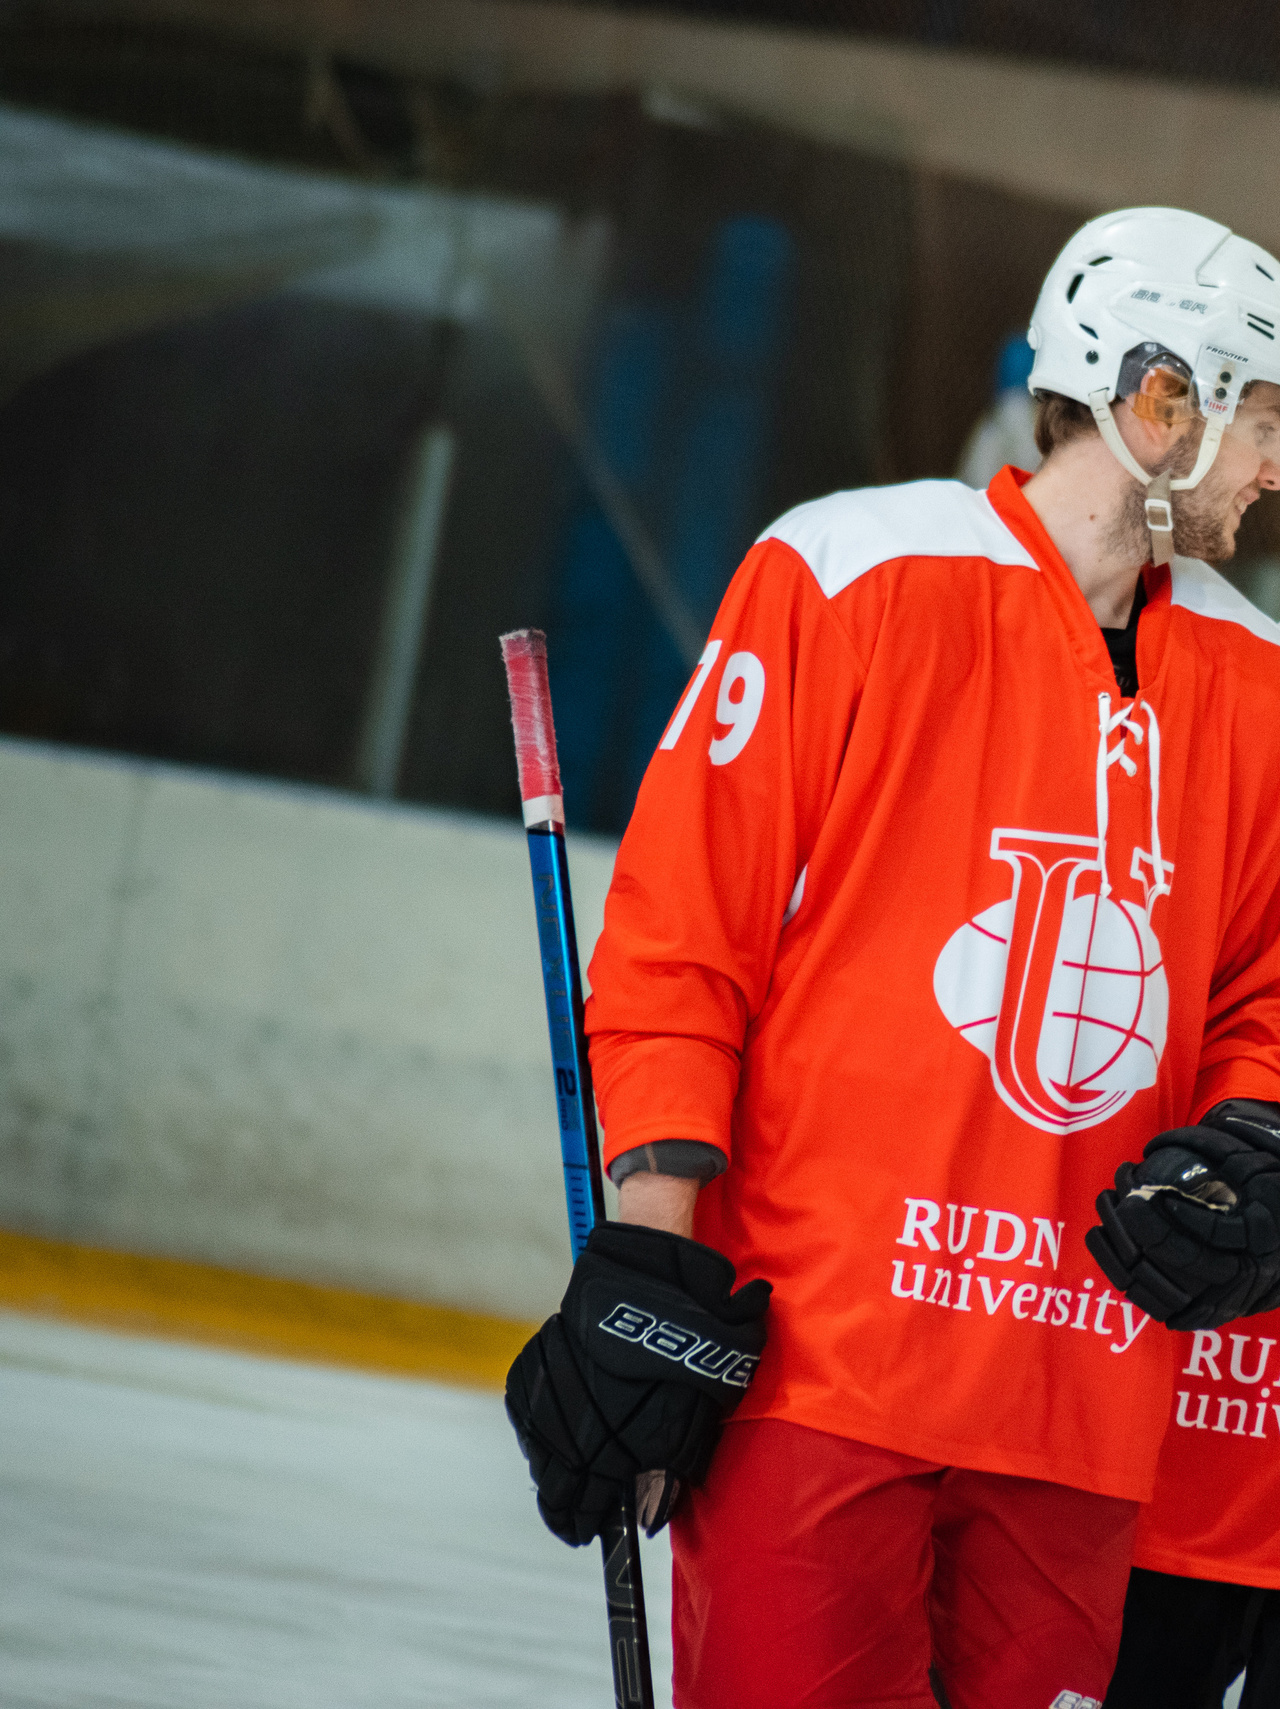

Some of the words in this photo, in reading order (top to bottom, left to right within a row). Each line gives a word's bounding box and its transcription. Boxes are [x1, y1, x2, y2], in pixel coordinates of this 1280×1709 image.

[1131, 289, 1208, 315] BAER
[1206, 345, 1249, 363] FRONTIER
[896, 1197, 1066, 1271] RUDN
[890, 1257, 1150, 1354] university
